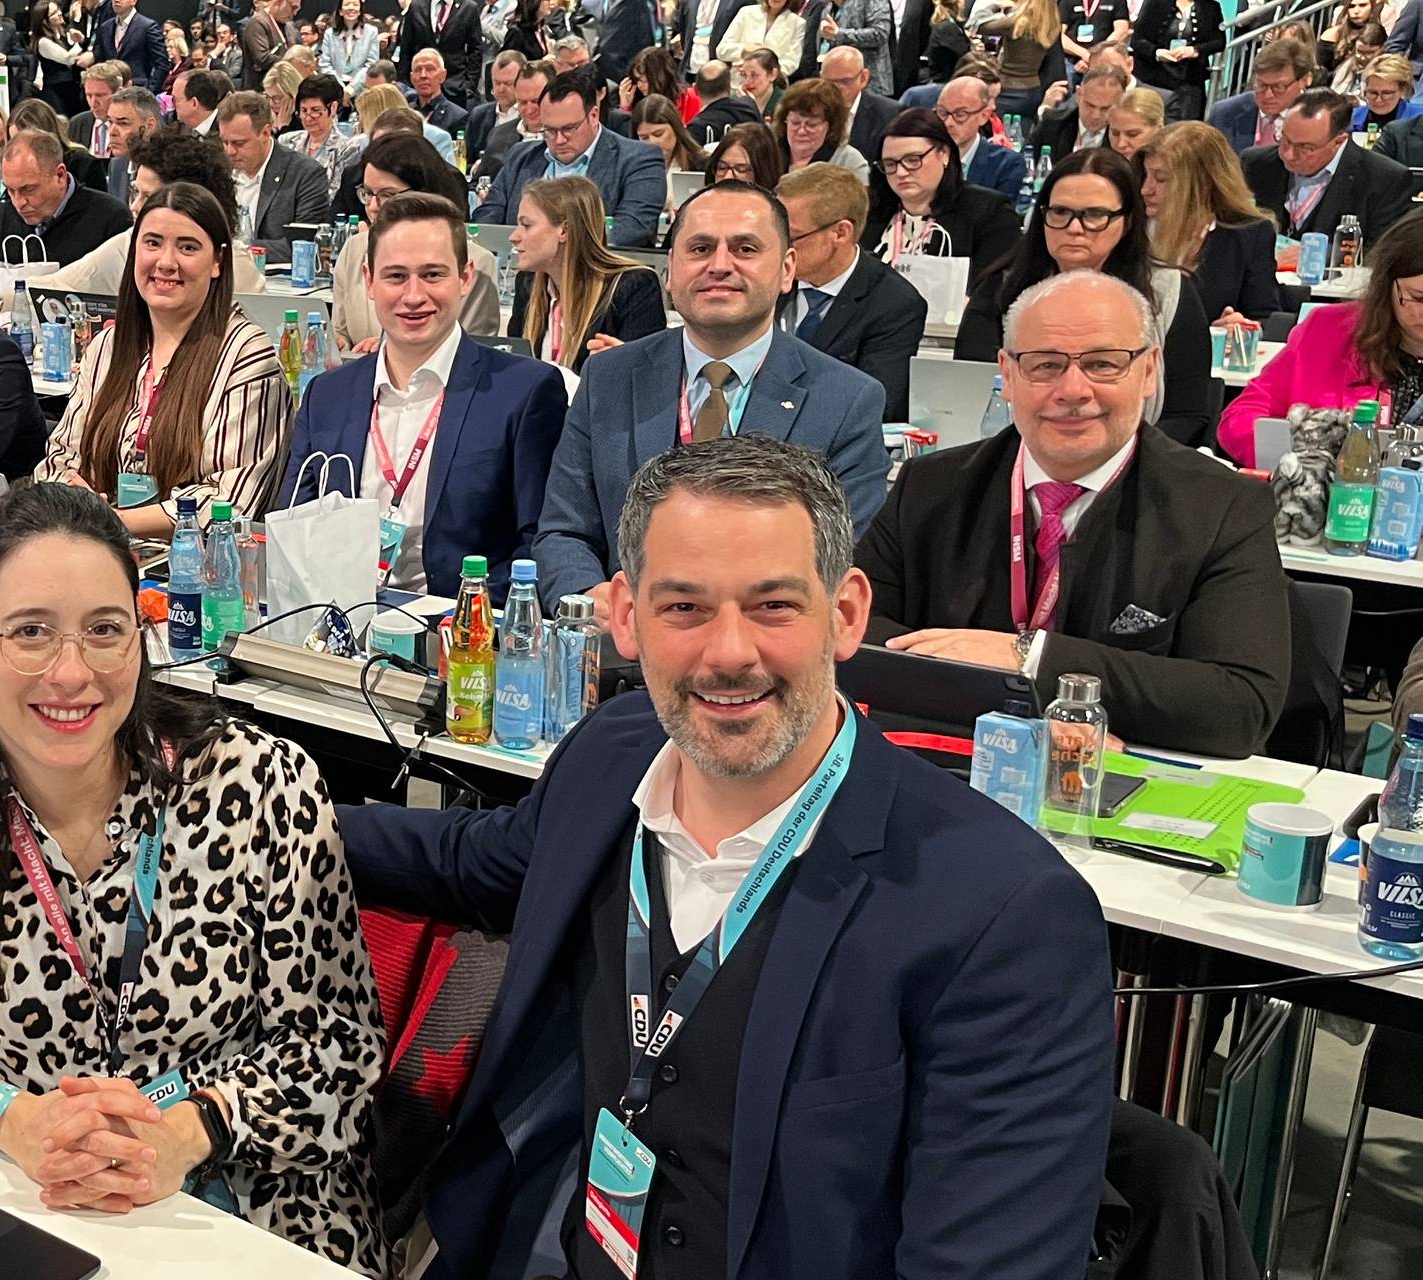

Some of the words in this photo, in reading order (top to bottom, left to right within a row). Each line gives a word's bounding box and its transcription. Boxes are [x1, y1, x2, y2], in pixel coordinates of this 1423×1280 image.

[407, 448, 421, 471] INSM
[1338, 503, 1370, 519] VILSA
[982, 733, 1018, 753] VILSA
[830, 752, 845, 768] 38.
[801, 768, 837, 811] Parteitag
[792, 809, 807, 829] der
[778, 828, 796, 852] CDU
[142, 837, 154, 876] chlands
[38, 882, 55, 902] mit
[737, 850, 782, 914] Deutschlands
[49, 903, 63, 926] alle
[59, 923, 73, 945] An
[117, 995, 128, 1027] CDU
[634, 1008, 648, 1047] CDU
[649, 1022, 674, 1056] CDU
[148, 1084, 176, 1104] CDU
